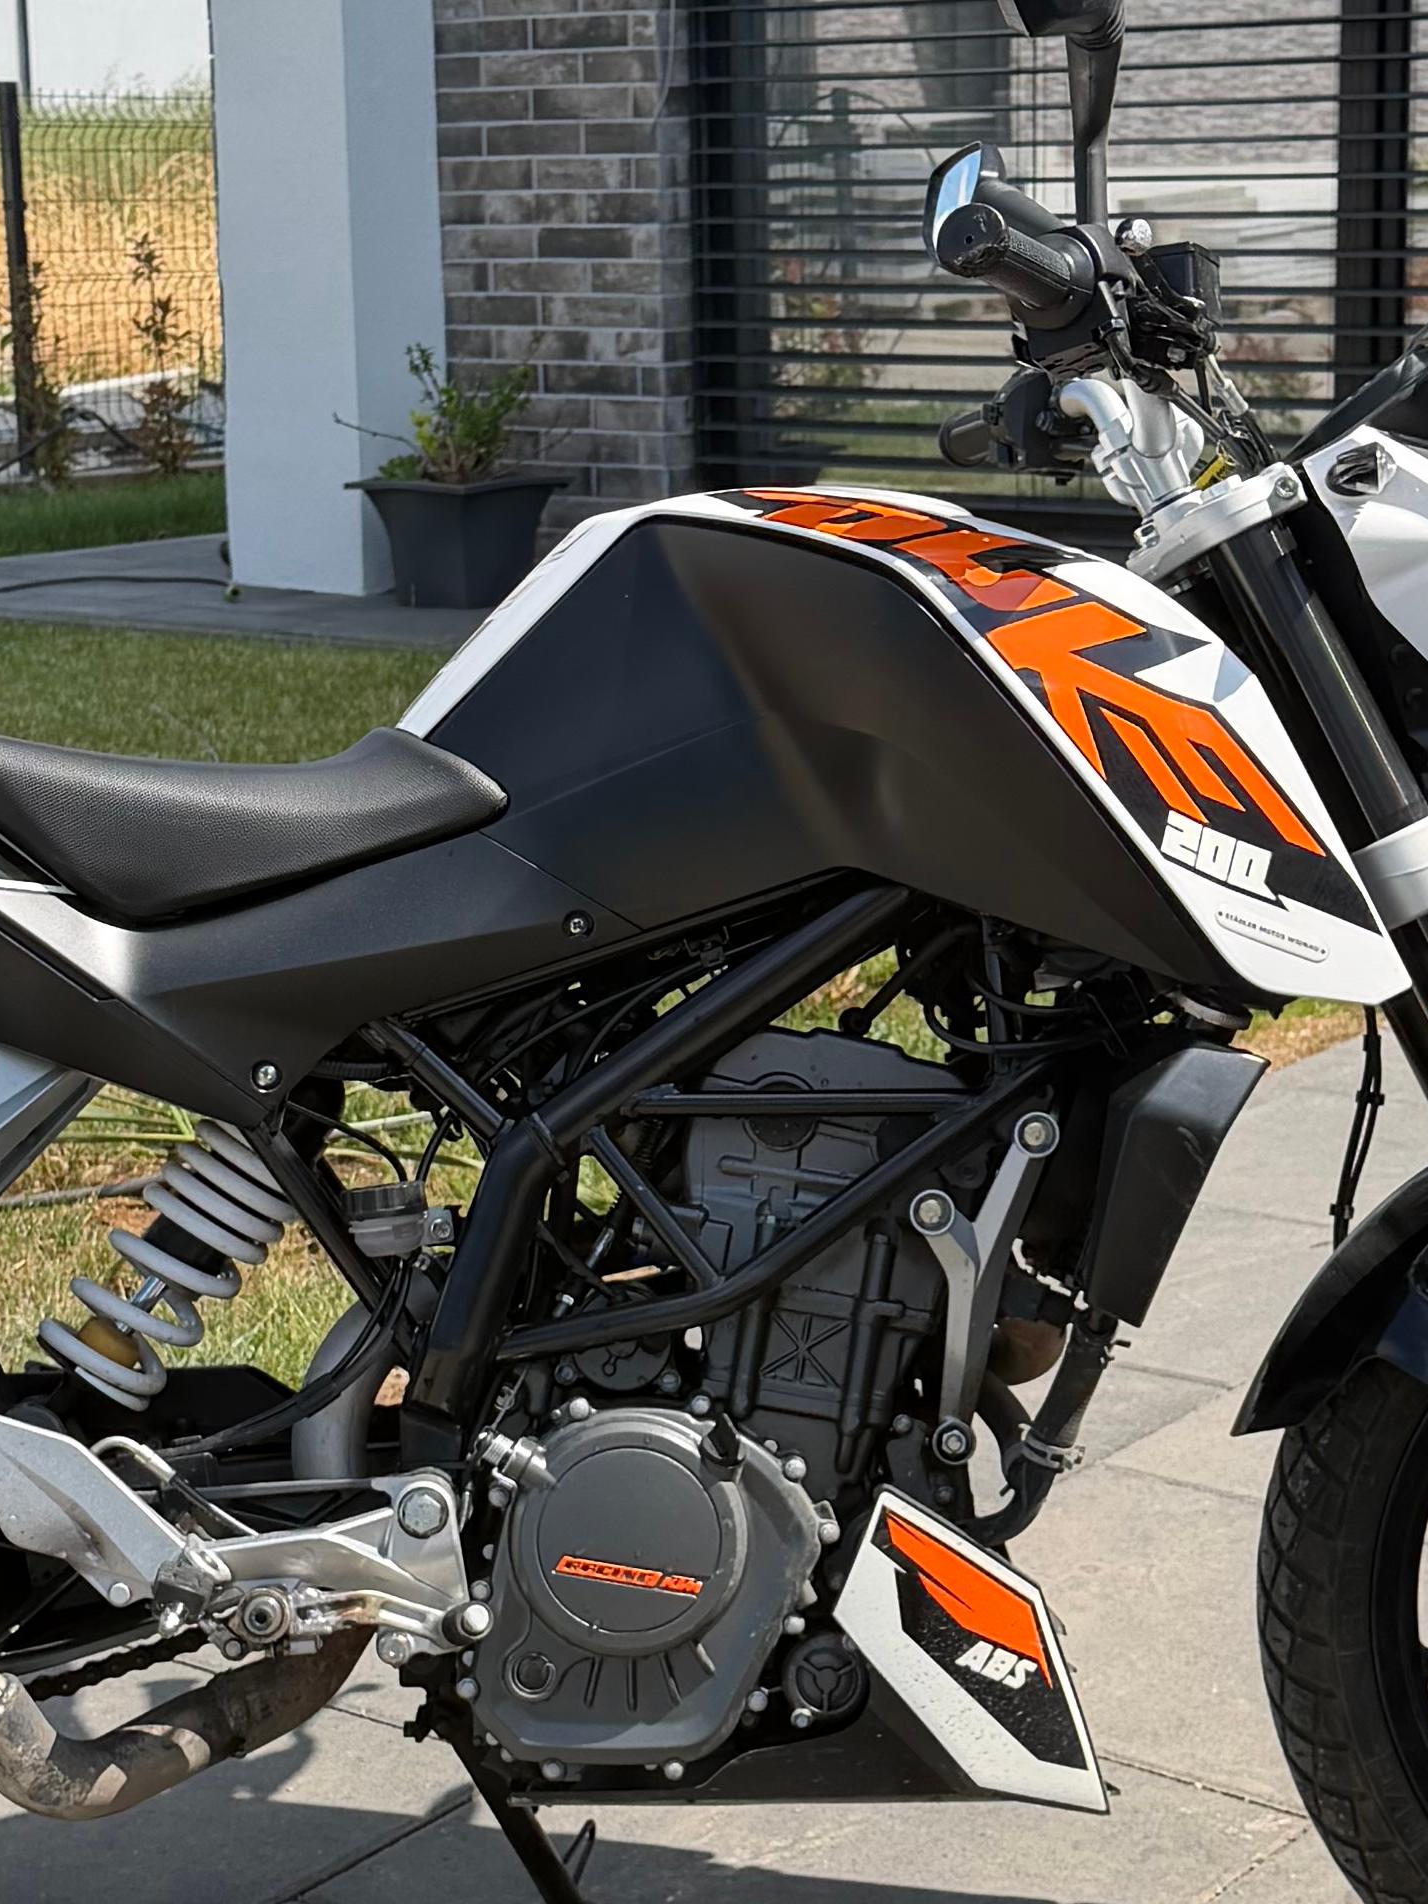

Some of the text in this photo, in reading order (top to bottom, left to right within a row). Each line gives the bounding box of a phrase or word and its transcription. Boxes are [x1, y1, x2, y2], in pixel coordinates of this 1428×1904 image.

[742, 489, 1325, 857] DUKE
[1160, 809, 1277, 901] 200
[954, 1640, 1038, 1689] ABS
